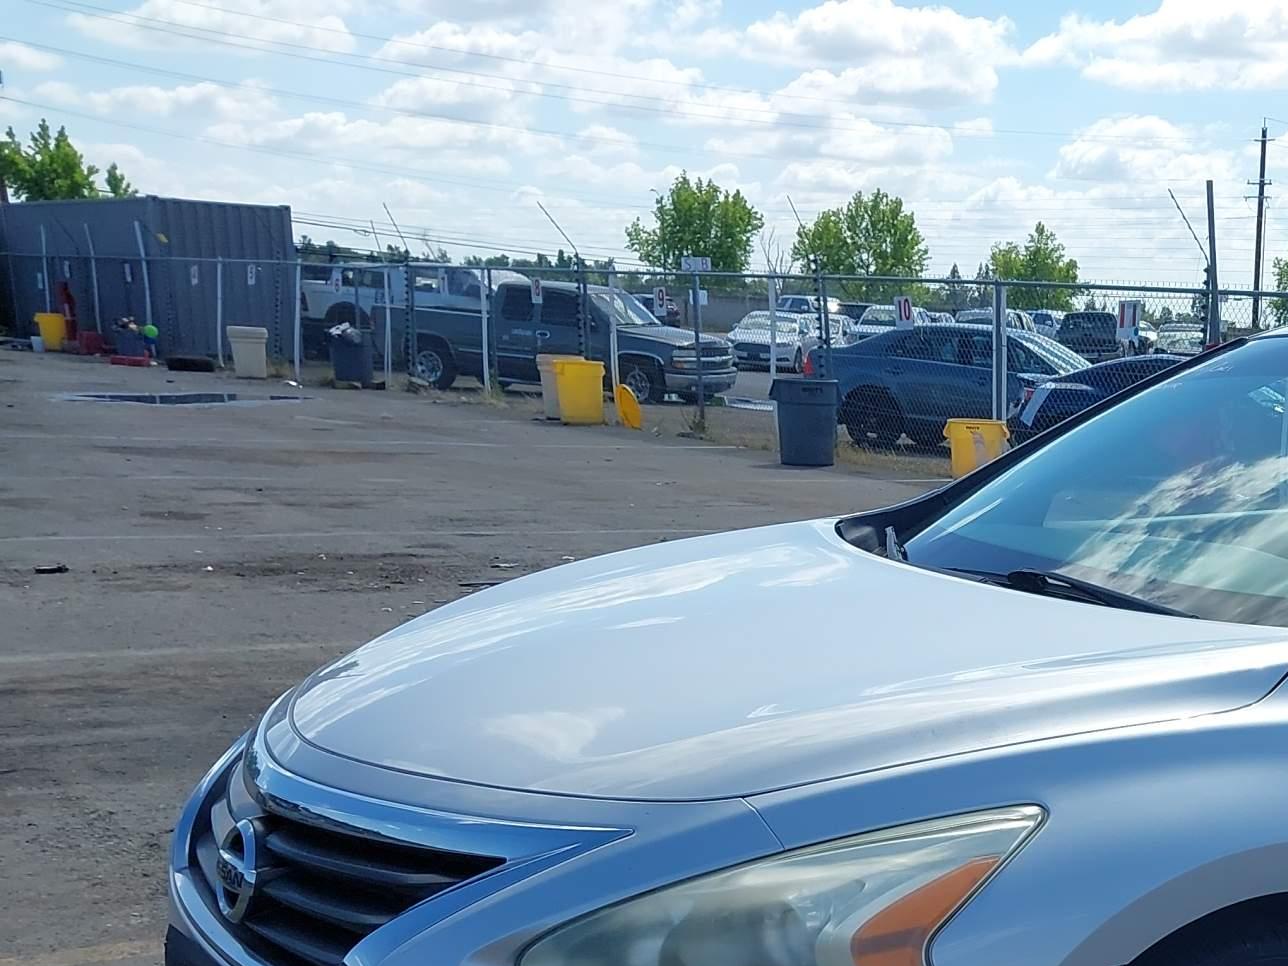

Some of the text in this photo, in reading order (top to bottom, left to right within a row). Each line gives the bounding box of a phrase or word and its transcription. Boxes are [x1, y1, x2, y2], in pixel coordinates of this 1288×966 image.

[684, 257, 709, 270] S B
[534, 279, 540, 297] 8
[657, 288, 665, 308] 9
[898, 298, 911, 322] 10
